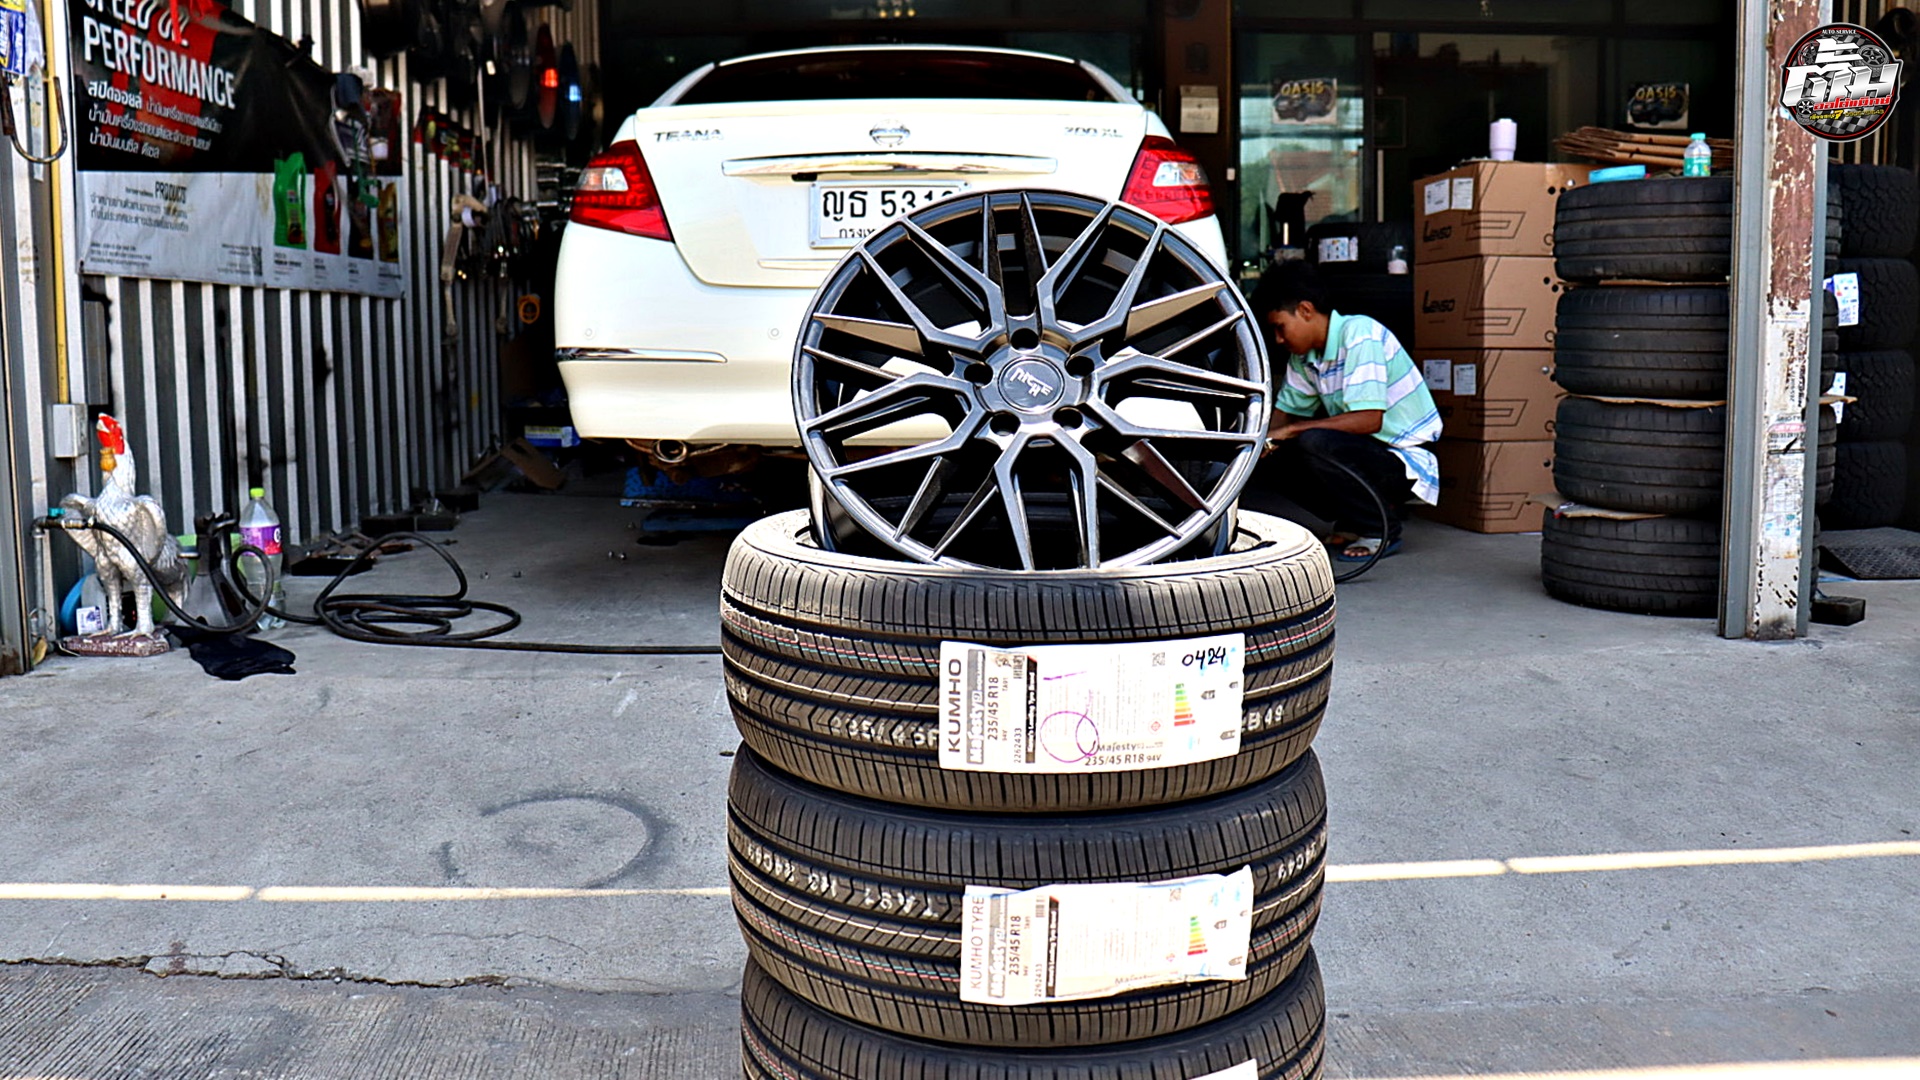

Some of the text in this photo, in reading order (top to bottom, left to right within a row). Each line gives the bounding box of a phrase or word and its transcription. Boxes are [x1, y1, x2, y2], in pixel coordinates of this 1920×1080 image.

[83, 15, 235, 109] PERFORMANCE
[1281, 81, 1324, 95] OASIS
[1635, 85, 1677, 99] OASIS
[653, 129, 724, 142] TEANA
[155, 181, 187, 204] PRODUCTS
[823, 190, 954, 221] ญธ 53
[1181, 646, 1227, 670] 0424
[948, 658, 961, 753] KUMHO
[987, 676, 999, 741] 235/45 R18
[1028, 691, 1036, 705] Tyre
[1028, 705, 1036, 729] Leading
[1014, 727, 1022, 763] 2262433
[1084, 753, 1163, 766] 235/45 R18 94V
[970, 896, 984, 989] KUMHO TYRE
[1008, 915, 1021, 976] 235/45 R18
